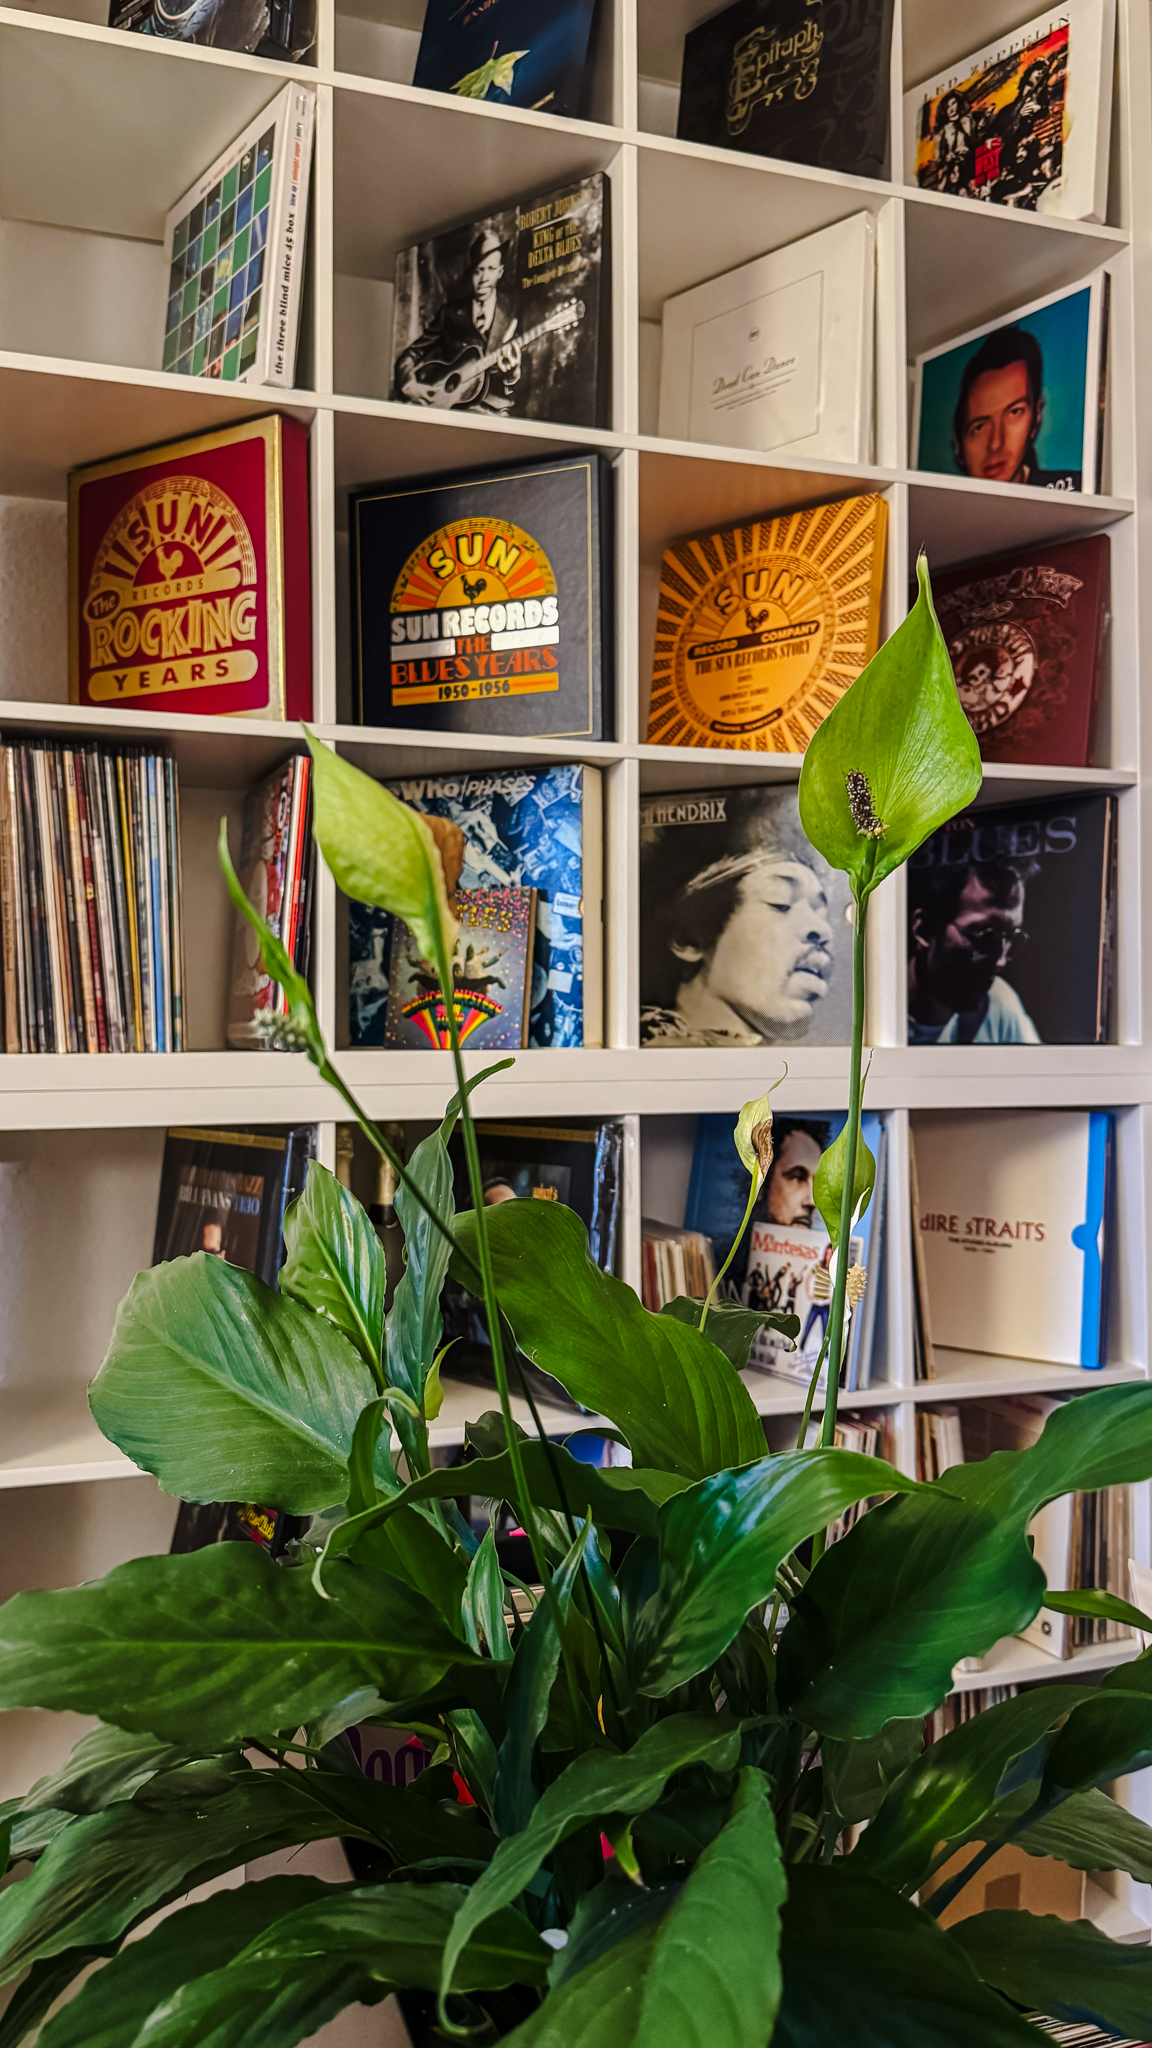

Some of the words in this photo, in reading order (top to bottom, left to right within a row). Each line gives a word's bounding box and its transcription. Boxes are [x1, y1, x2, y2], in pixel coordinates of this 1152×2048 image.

[729, 20, 823, 106] Epitaph
[923, 77, 958, 102] LED
[970, 13, 1071, 77] ZEPPELIN
[286, 212, 296, 233] box
[517, 203, 553, 231] ROBERT
[285, 236, 295, 251] 45
[528, 245, 554, 269] DELTA
[555, 233, 583, 259] BLUES
[533, 227, 555, 249] KING
[283, 254, 292, 282] mice
[280, 285, 290, 316] blind
[278, 319, 287, 351] three
[275, 354, 284, 375] the
[127, 496, 214, 553] SUN
[426, 532, 521, 580] SUN
[132, 577, 205, 601] RECORDS
[714, 568, 803, 616] SUN
[91, 594, 117, 618] The
[391, 612, 439, 643] SUN
[442, 596, 559, 638] RECORDS
[88, 590, 258, 669] ROCKING
[455, 633, 491, 655] THE
[693, 639, 738, 656] RECORD
[761, 621, 818, 643] COMPANY
[113, 658, 230, 692] YEARS
[391, 656, 471, 686] BLUES
[474, 646, 559, 678] YEARS
[401, 781, 461, 800] Who
[466, 776, 536, 796] PHASES
[657, 799, 727, 822] HENDRIX
[909, 815, 1078, 869] BLUES
[919, 1213, 959, 1235] dIRE
[965, 1216, 1045, 1242] sTRAITS
